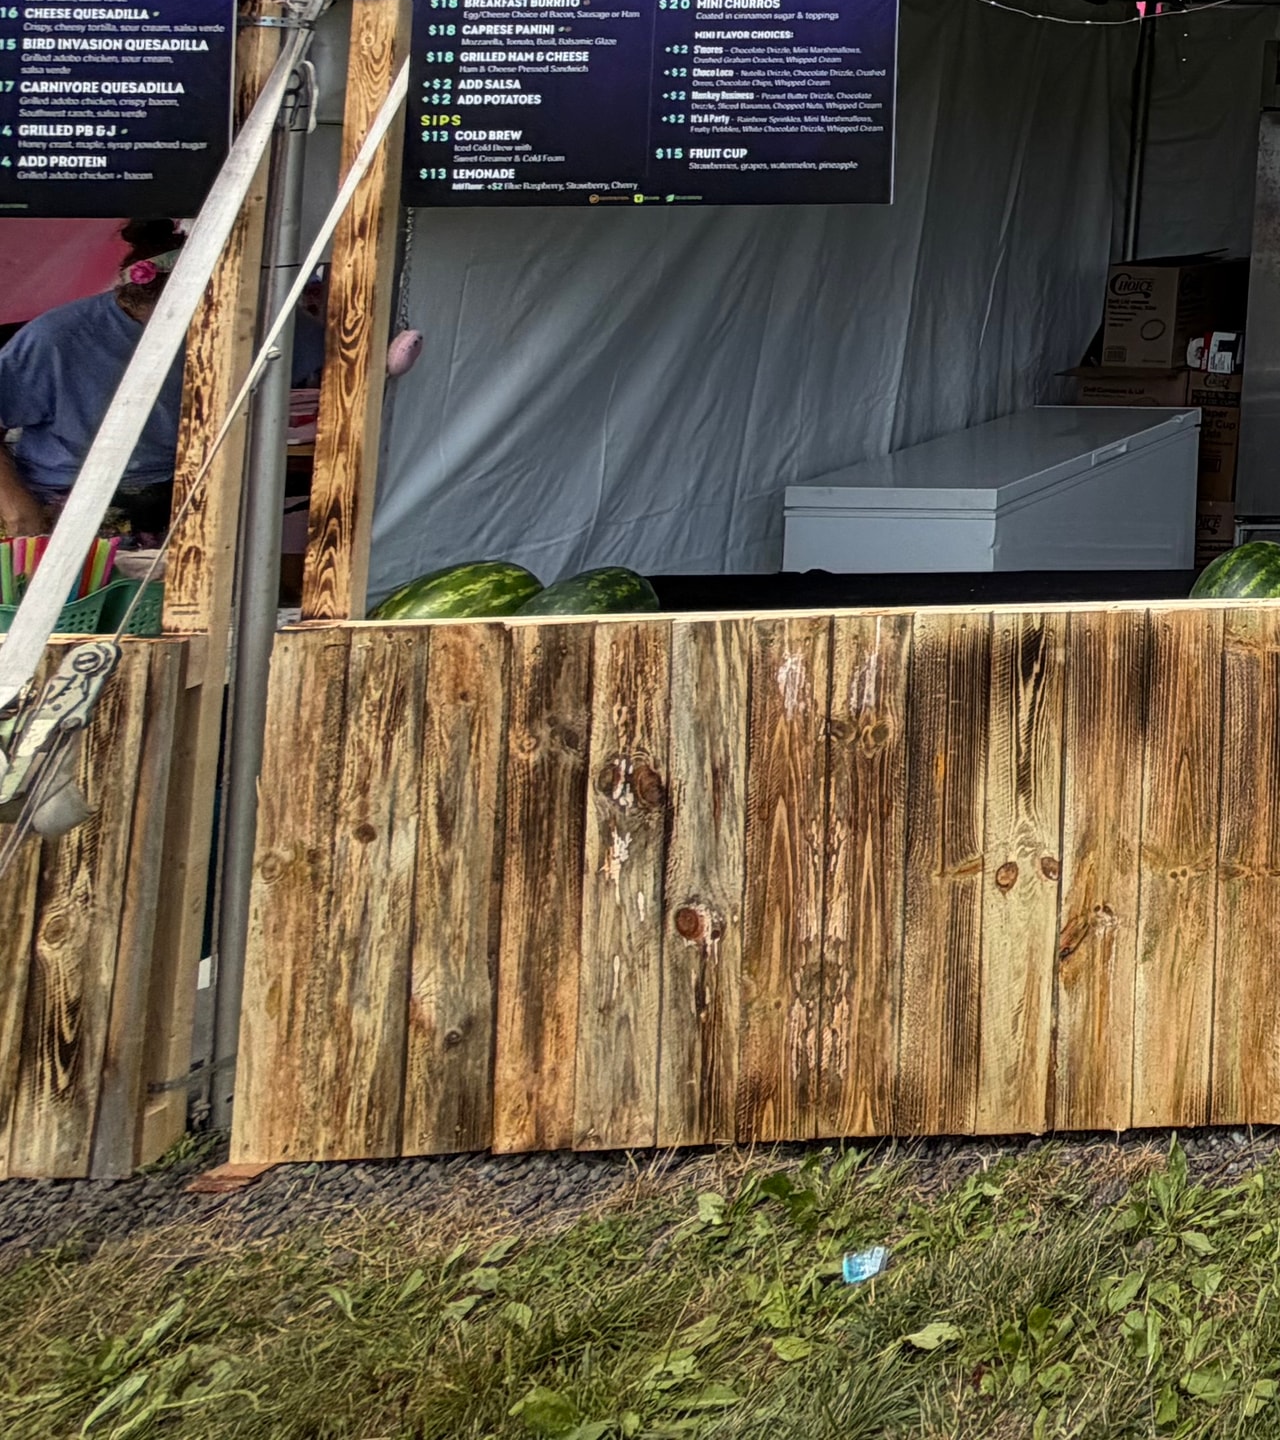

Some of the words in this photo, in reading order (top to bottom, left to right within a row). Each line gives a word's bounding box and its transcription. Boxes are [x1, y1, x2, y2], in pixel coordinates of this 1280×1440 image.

[24, 7, 72, 20] CHEESE
[73, 8, 149, 21] QUESADILLA
[428, 25, 456, 36] $18
[462, 25, 514, 35] CAPRESE
[515, 25, 555, 35] PANINI
[22, 38, 56, 50] BIRD
[57, 38, 123, 51] INVASION
[124, 39, 209, 52] QUESADILLA
[426, 52, 454, 63] $18
[460, 51, 506, 62] GRILLED
[508, 51, 535, 62] HAM
[545, 51, 589, 62] CHEESE
[20, 81, 99, 94] CARNIVORE
[101, 82, 185, 95] QUESADILLA
[458, 79, 483, 90] ADD
[484, 79, 521, 90] SALSA
[457, 94, 483, 105] ADD
[483, 94, 542, 105] POTATOES
[420, 115, 462, 126] SIPS
[18, 125, 74, 137] GRILLED
[421, 130, 449, 142] $13
[455, 130, 487, 141] COLD
[488, 130, 523, 141] BREW
[655, 147, 683, 159] $15
[689, 148, 722, 159] FRUIT
[723, 148, 748, 159] CUP
[18, 156, 47, 168] ADD
[49, 156, 107, 168] PROTEIN
[419, 168, 447, 180] $13
[453, 168, 515, 179] LEMONADE
[1110, 273, 1155, 298] CHOICE
